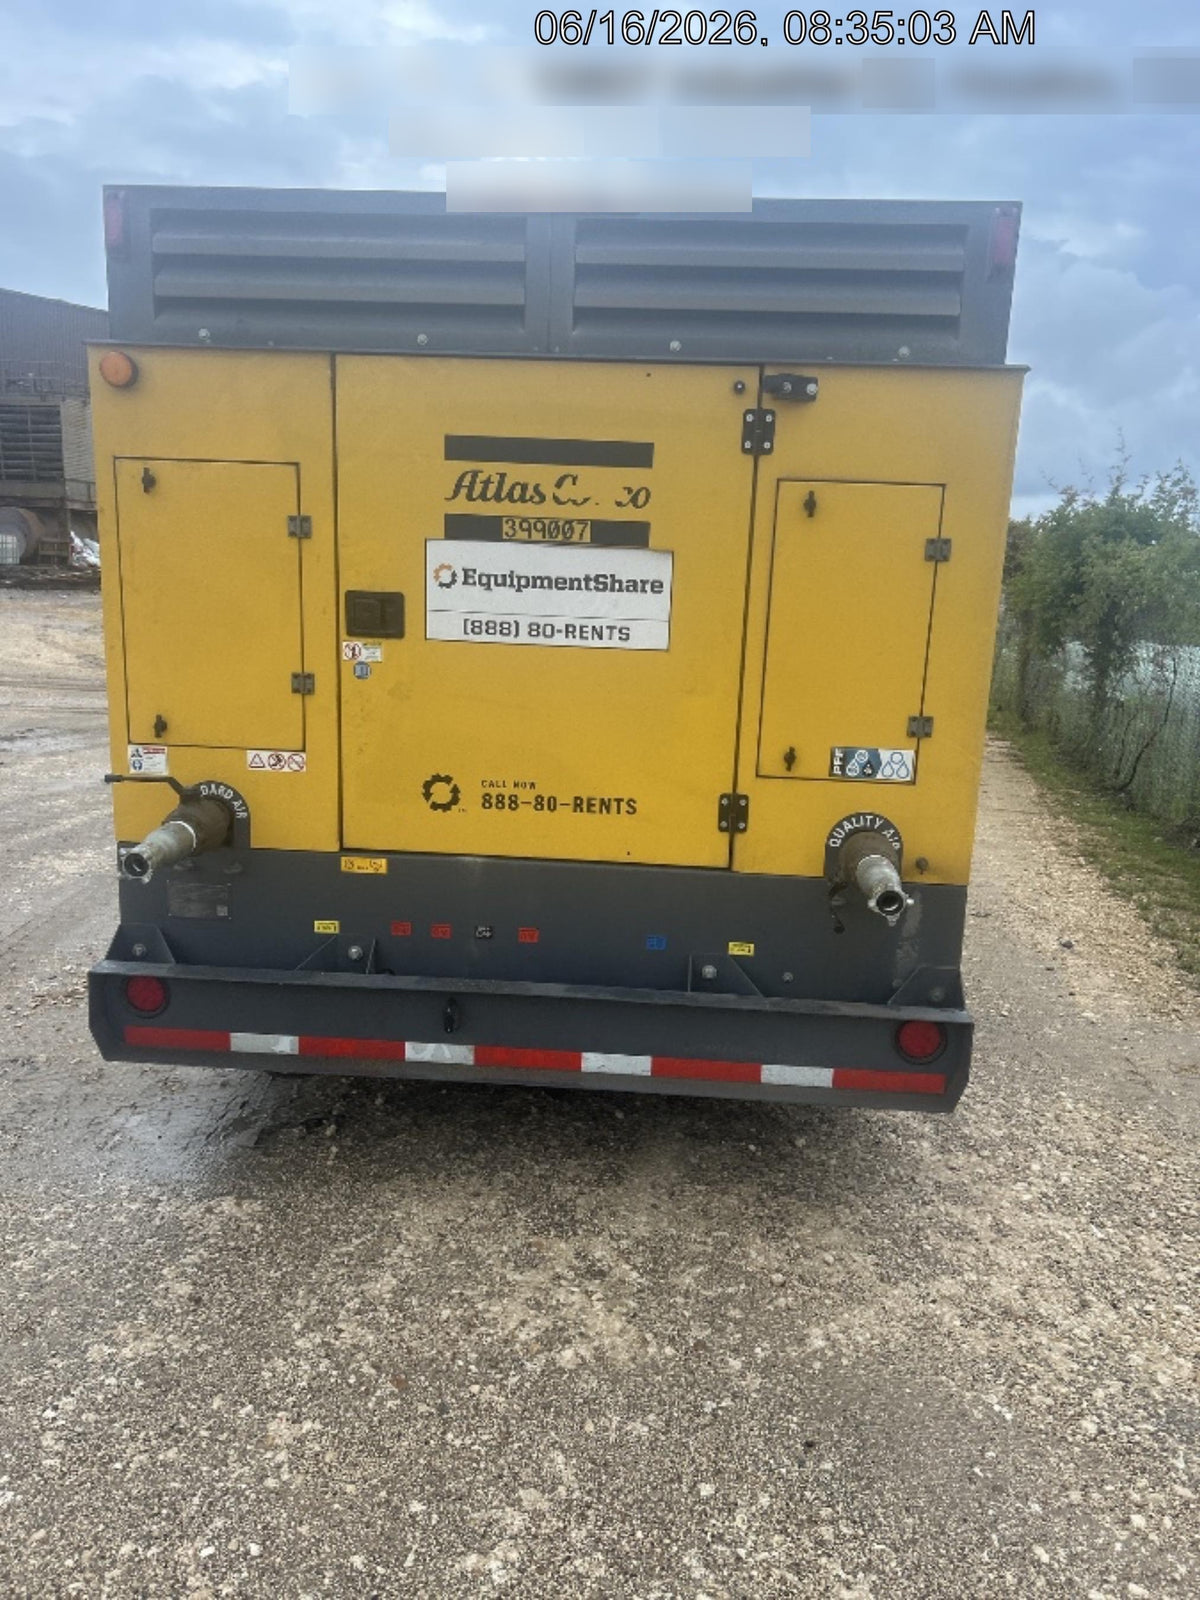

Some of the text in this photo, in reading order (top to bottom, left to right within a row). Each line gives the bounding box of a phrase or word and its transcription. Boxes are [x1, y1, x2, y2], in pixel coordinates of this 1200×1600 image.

[444, 469, 547, 505] Atlas
[503, 517, 590, 541] 399007
[461, 567, 664, 595] EquipmentShare
[463, 618, 631, 642] (888) 80-RENTS
[481, 779, 537, 790] CALL NOW
[481, 792, 638, 816] 888-80-RENTS
[828, 815, 885, 847] QUALITY
